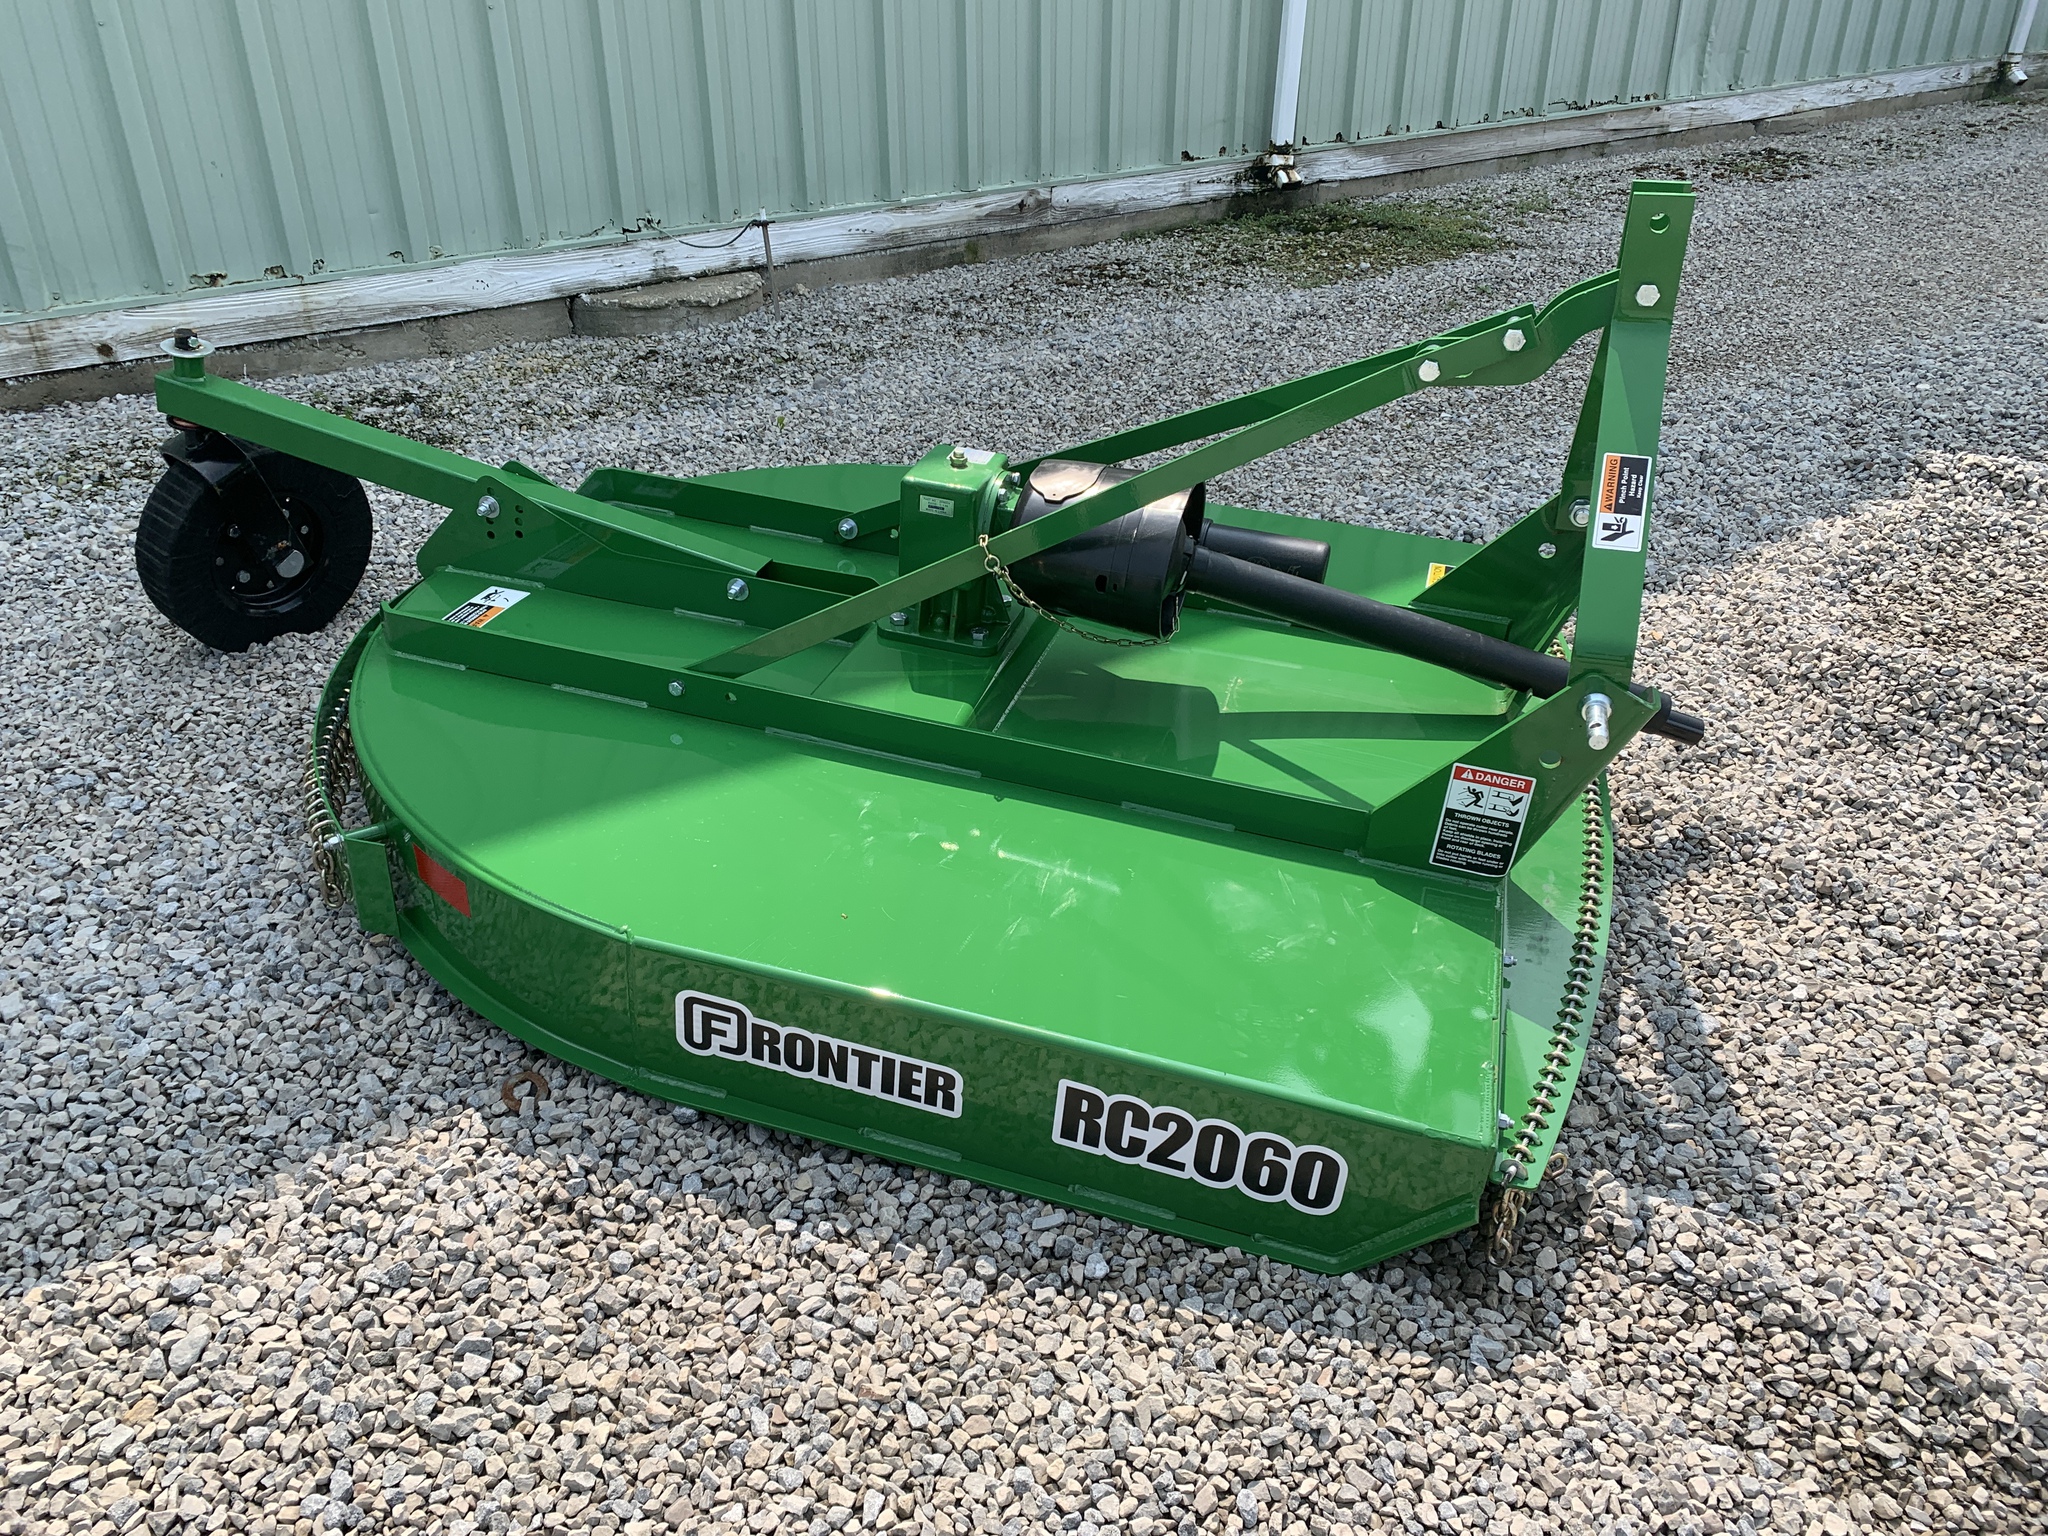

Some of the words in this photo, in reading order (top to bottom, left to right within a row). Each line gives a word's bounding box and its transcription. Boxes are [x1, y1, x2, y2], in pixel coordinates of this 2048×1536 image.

[1605, 458, 1618, 503] WARNING
[1622, 467, 1630, 484] Point
[1628, 474, 1638, 497] Hazard
[1618, 484, 1627, 504] Pinch
[1475, 772, 1526, 790] DANGER
[1454, 812, 1481, 822] THROWN
[1481, 818, 1510, 827] OBJECTS
[1446, 844, 1476, 854] ROTATING
[1476, 850, 1501, 859] BLADES
[683, 995, 958, 1111] FRONTIER
[1060, 1084, 1340, 1209] RC2060
